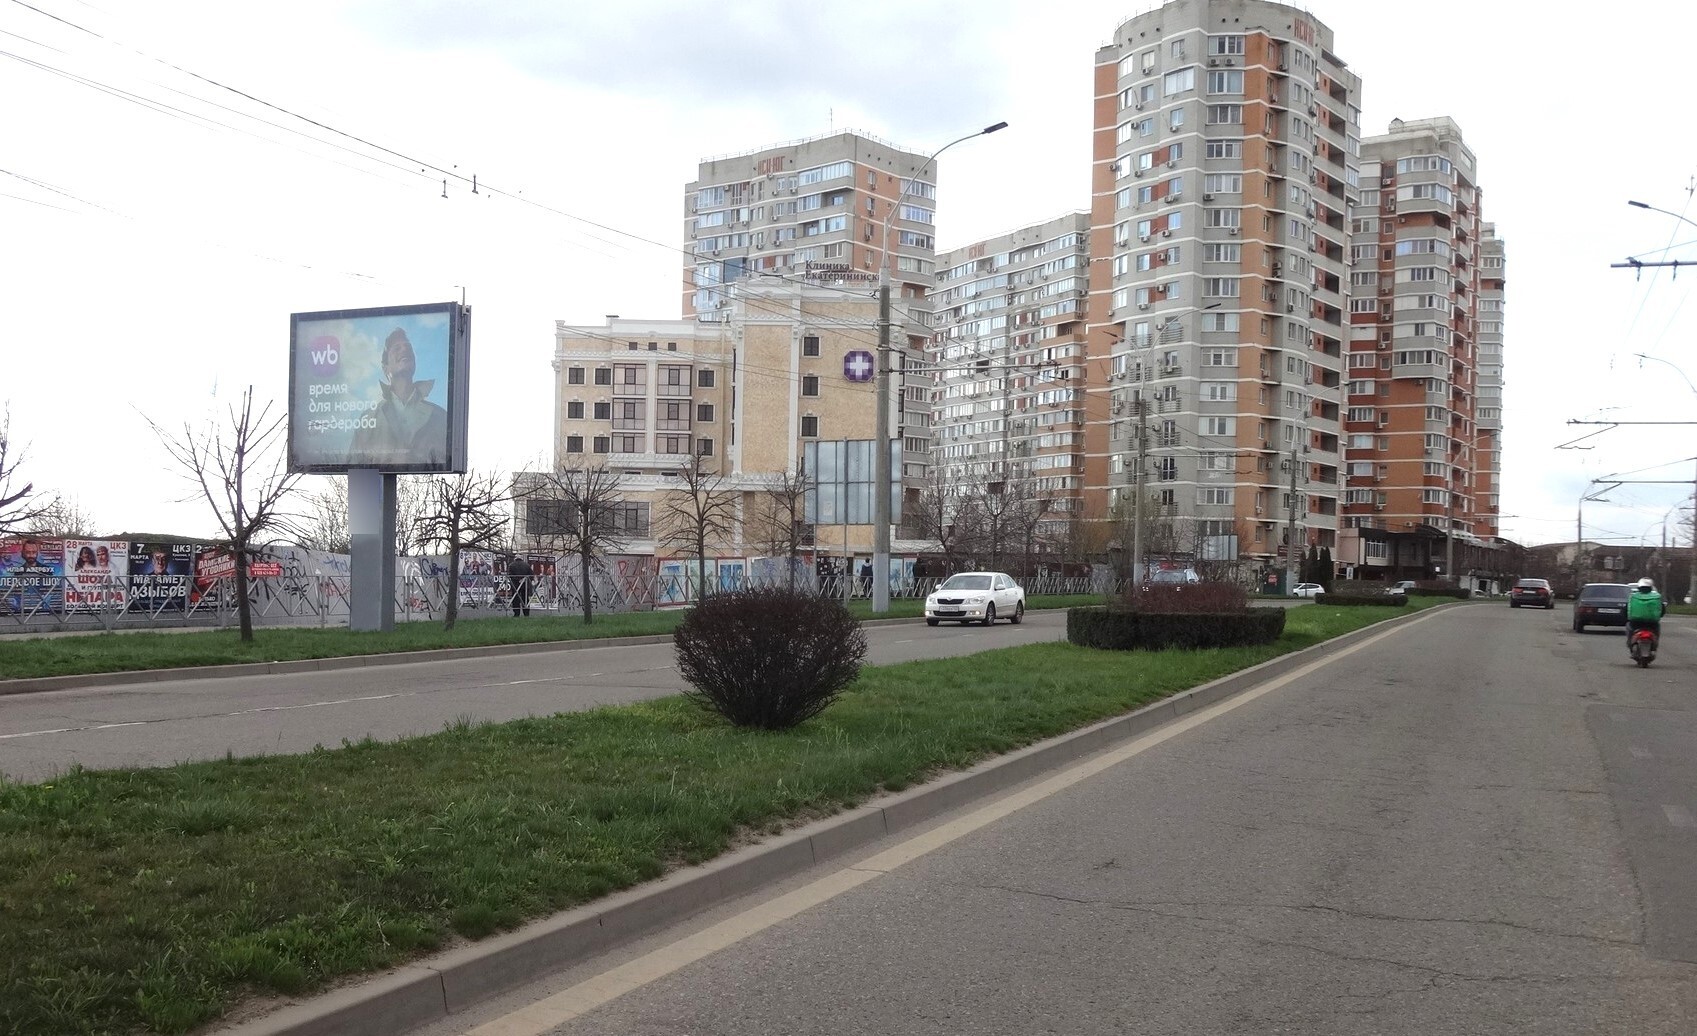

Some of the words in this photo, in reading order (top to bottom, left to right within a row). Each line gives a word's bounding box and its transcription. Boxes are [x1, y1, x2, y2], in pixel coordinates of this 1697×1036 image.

[805, 260, 850, 270] Клиника
[311, 344, 339, 366] wb
[309, 383, 348, 397] время
[308, 399, 331, 413] для
[334, 401, 377, 412] нового
[308, 415, 377, 433] гардероба
[66, 541, 77, 549] 28
[136, 543, 145, 554] 7
[172, 544, 191, 554] ЦКЗ
